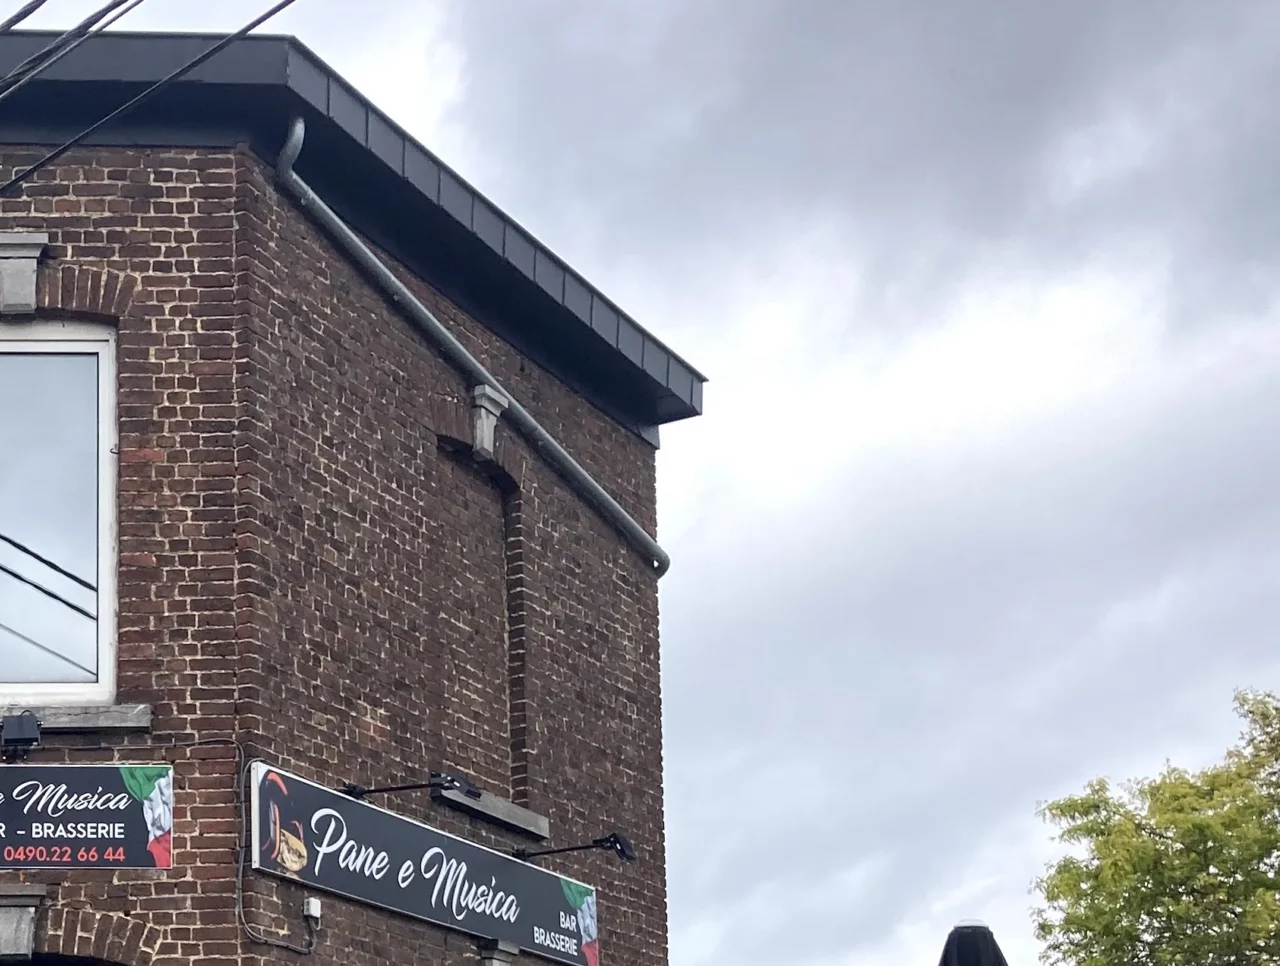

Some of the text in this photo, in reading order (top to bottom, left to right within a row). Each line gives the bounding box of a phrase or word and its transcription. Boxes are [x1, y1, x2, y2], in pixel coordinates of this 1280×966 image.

[12, 780, 132, 817] Musica
[32, 822, 125, 839] BRASSERIE
[4, 846, 126, 862] 0490.22 66 44
[310, 808, 519, 924] Pane e Musica
[560, 911, 577, 932] BAR
[534, 926, 578, 956] BRASSERIE
